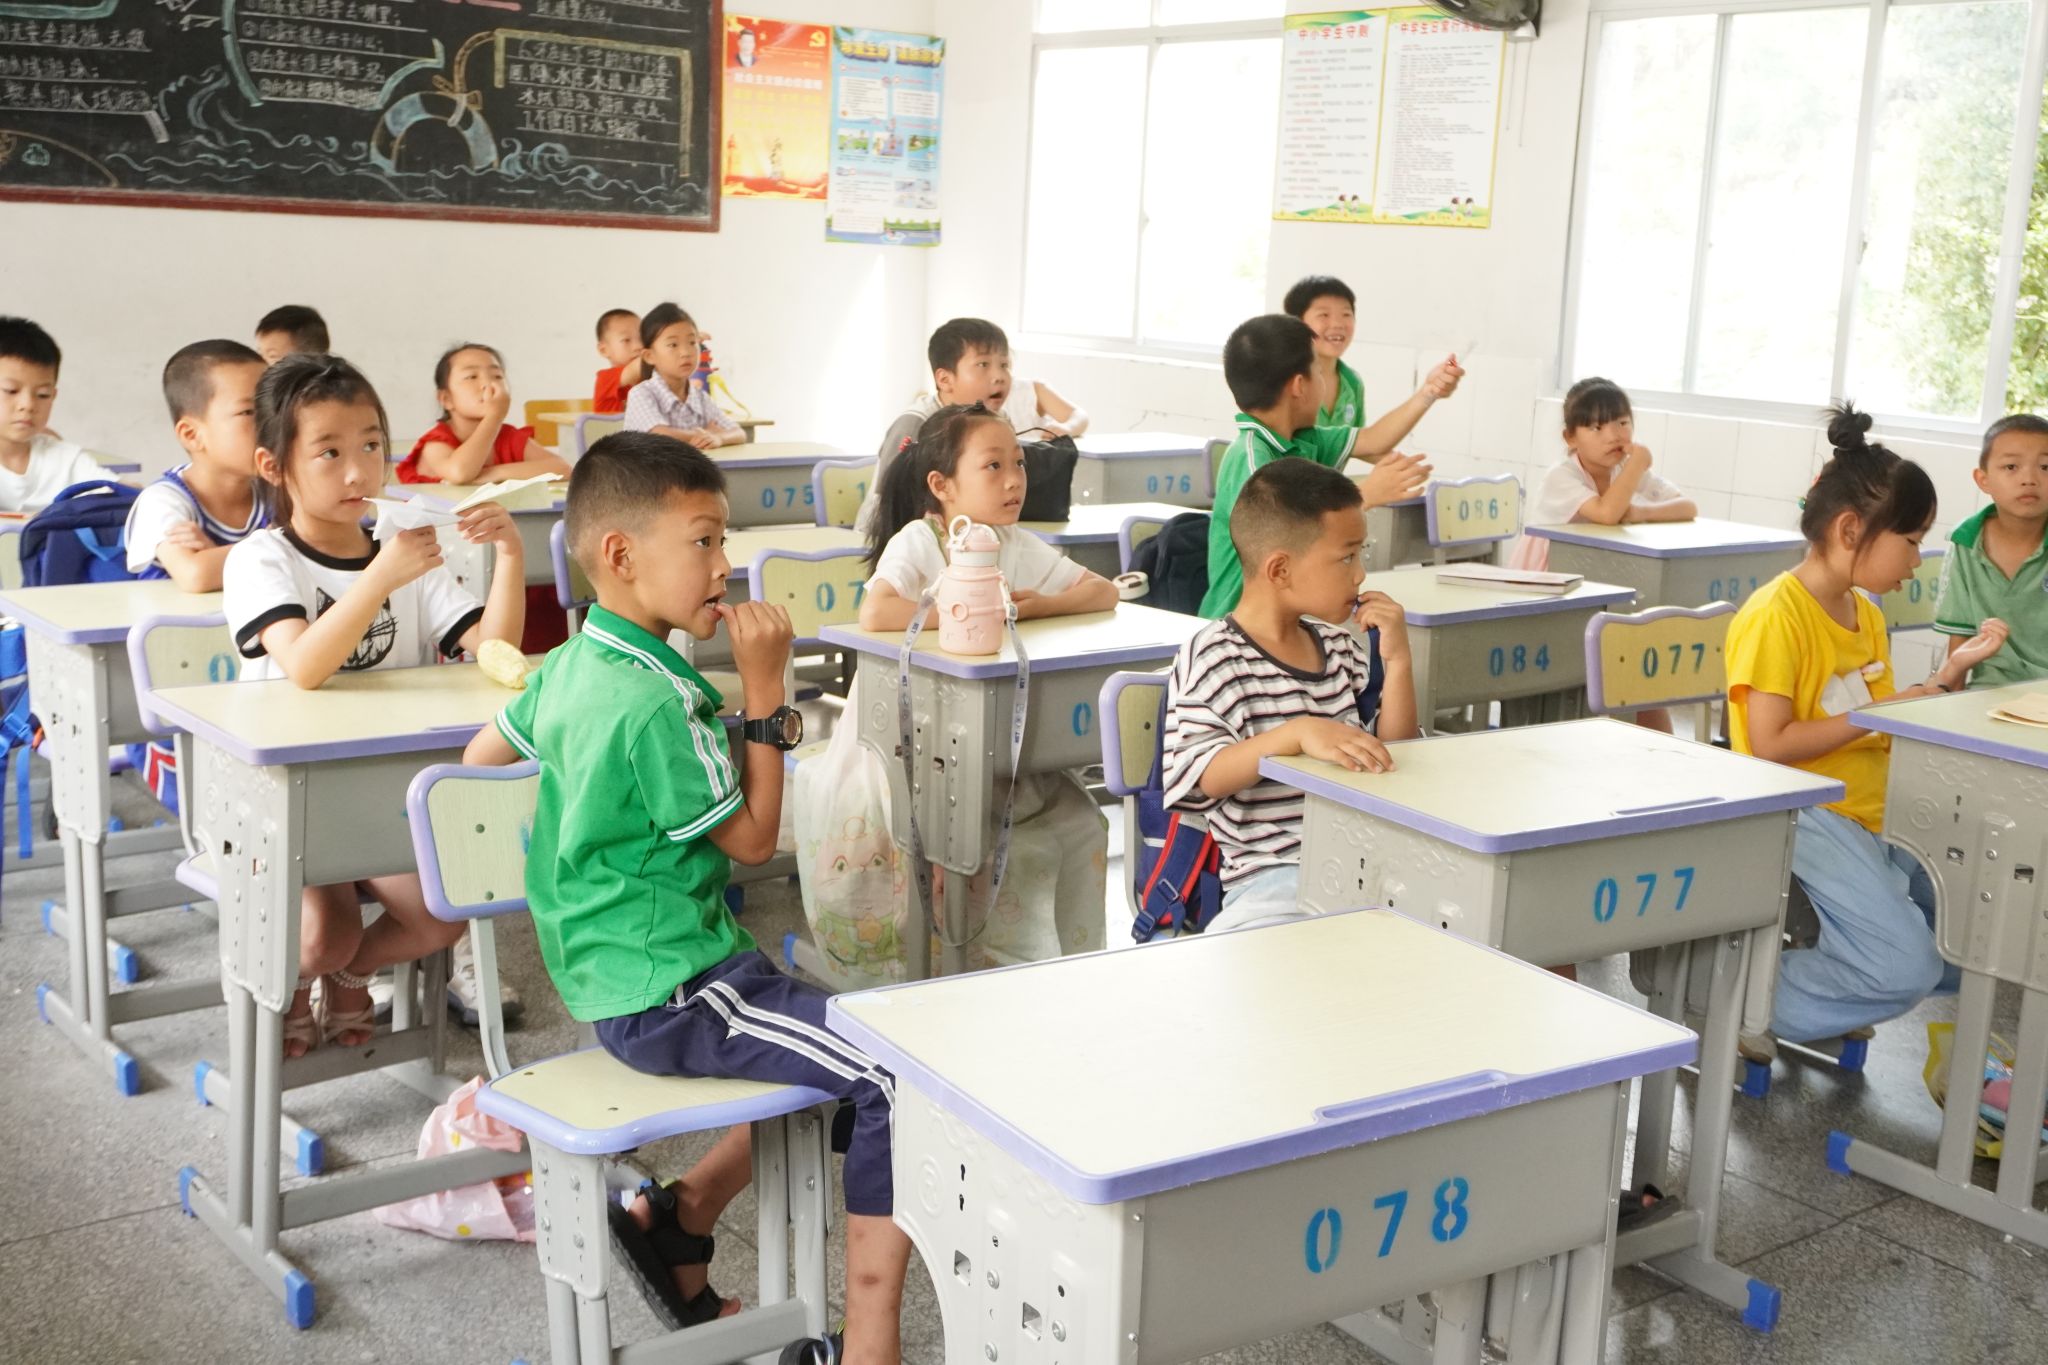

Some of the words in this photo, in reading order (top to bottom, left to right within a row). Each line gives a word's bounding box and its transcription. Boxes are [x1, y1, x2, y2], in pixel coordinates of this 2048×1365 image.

[761, 485, 814, 508] 075
[1147, 475, 1191, 494] 076
[1490, 644, 1550, 678] 084
[1643, 643, 1704, 678] 077
[1594, 867, 1694, 922] 077
[1305, 1177, 1469, 1273] 078
